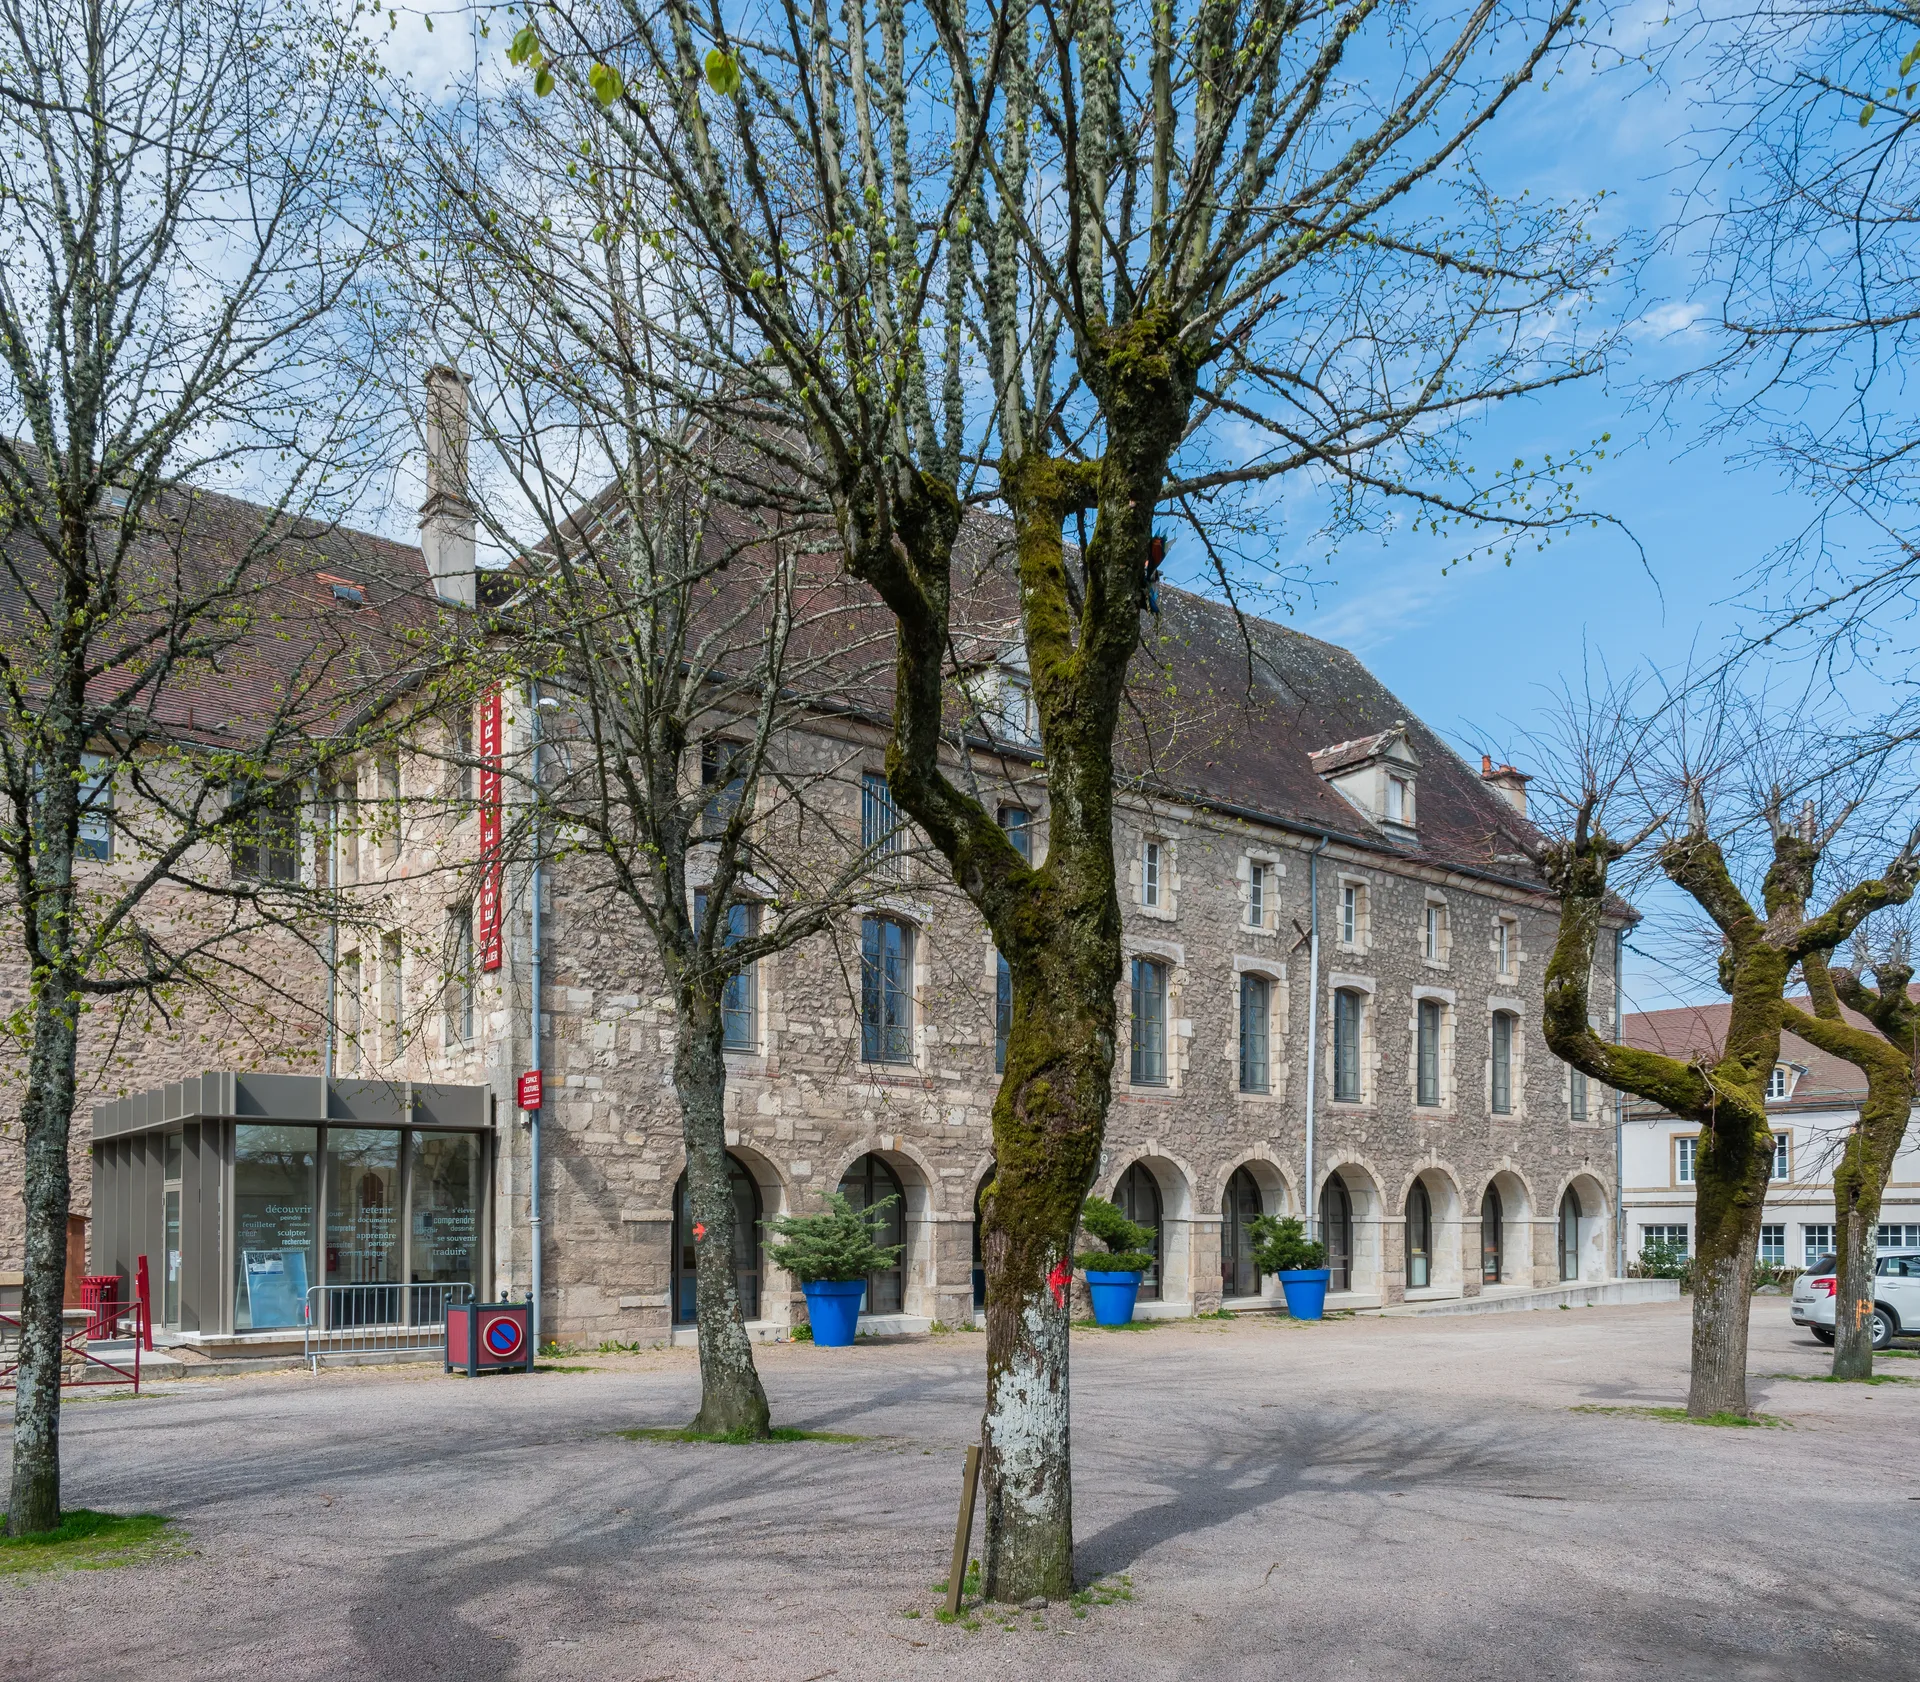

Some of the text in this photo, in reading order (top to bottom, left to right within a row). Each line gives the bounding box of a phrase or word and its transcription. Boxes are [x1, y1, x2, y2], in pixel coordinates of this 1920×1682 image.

[481, 936, 497, 950] CLUDE
[265, 1204, 312, 1214] découvrir
[361, 1206, 393, 1214] retenir
[433, 1215, 475, 1226] comprendre
[277, 1229, 307, 1237] sculpter
[356, 1232, 397, 1240] apprendre
[433, 1248, 467, 1256] traduire
